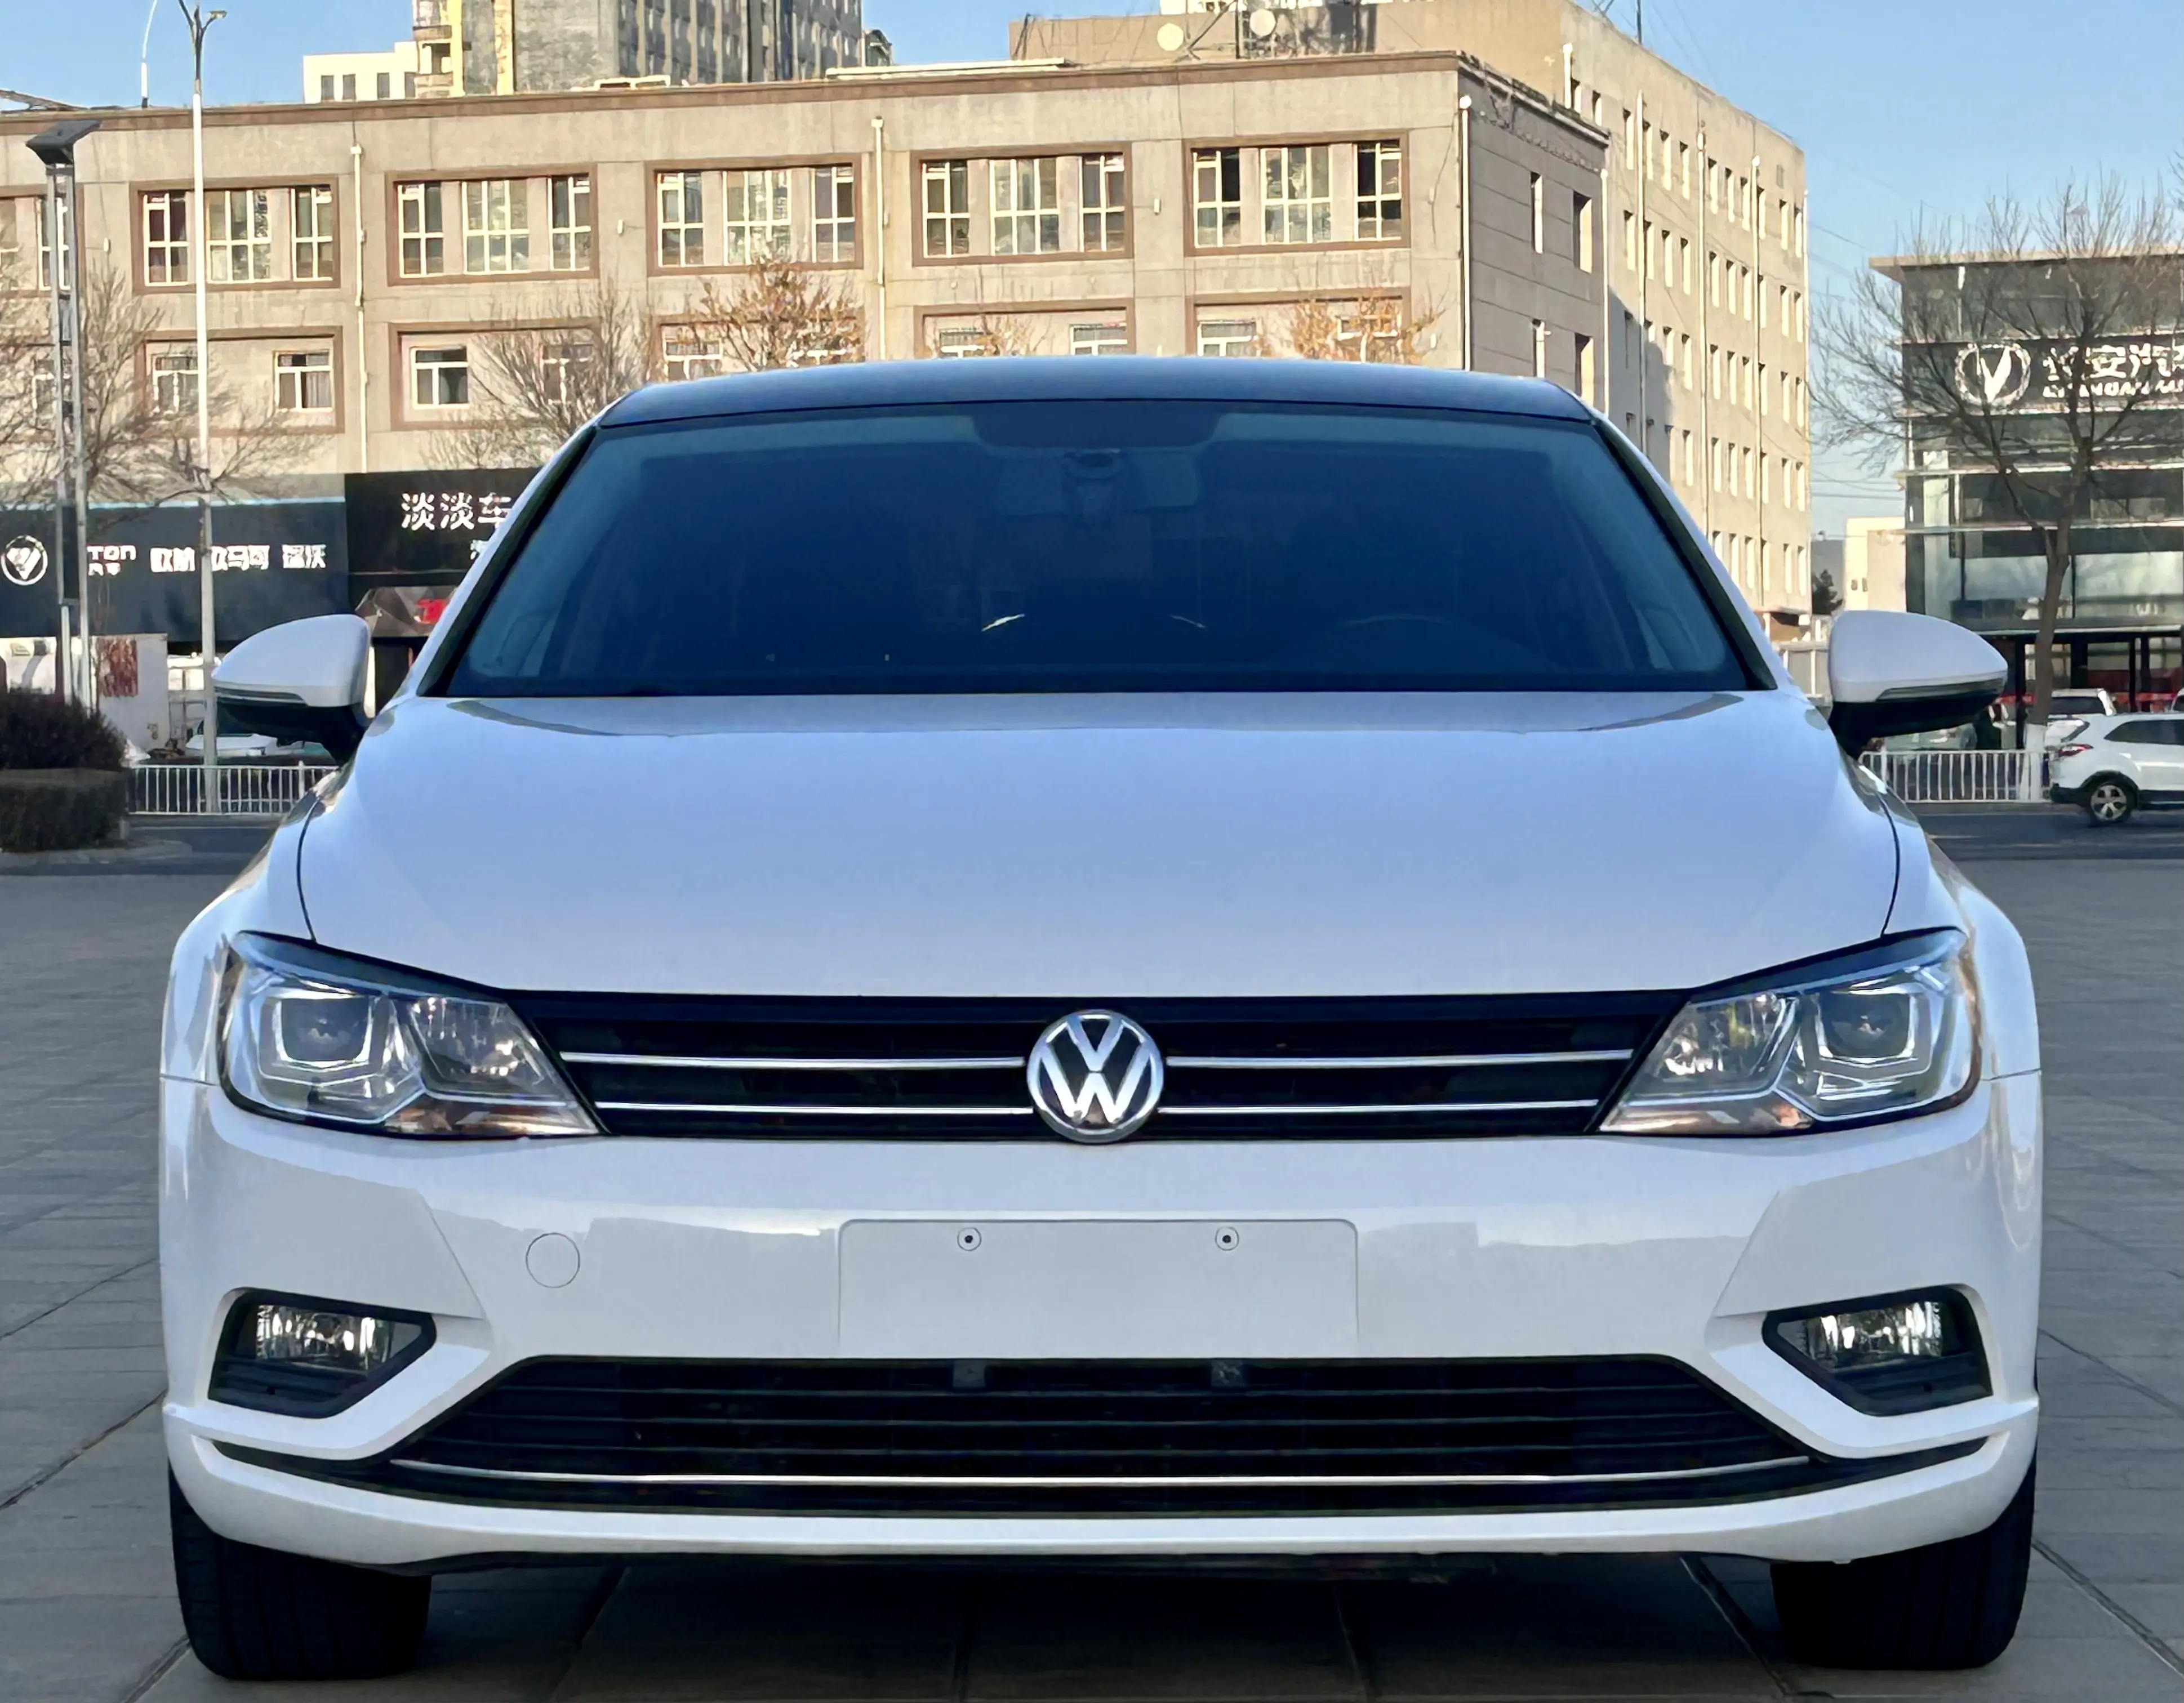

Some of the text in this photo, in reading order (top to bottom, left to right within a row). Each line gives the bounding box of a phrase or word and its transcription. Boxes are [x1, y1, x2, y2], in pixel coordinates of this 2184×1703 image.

[401, 492, 513, 531] 淡淡车
[86, 545, 137, 561] TON
[1032, 1010, 1159, 1136] VW
